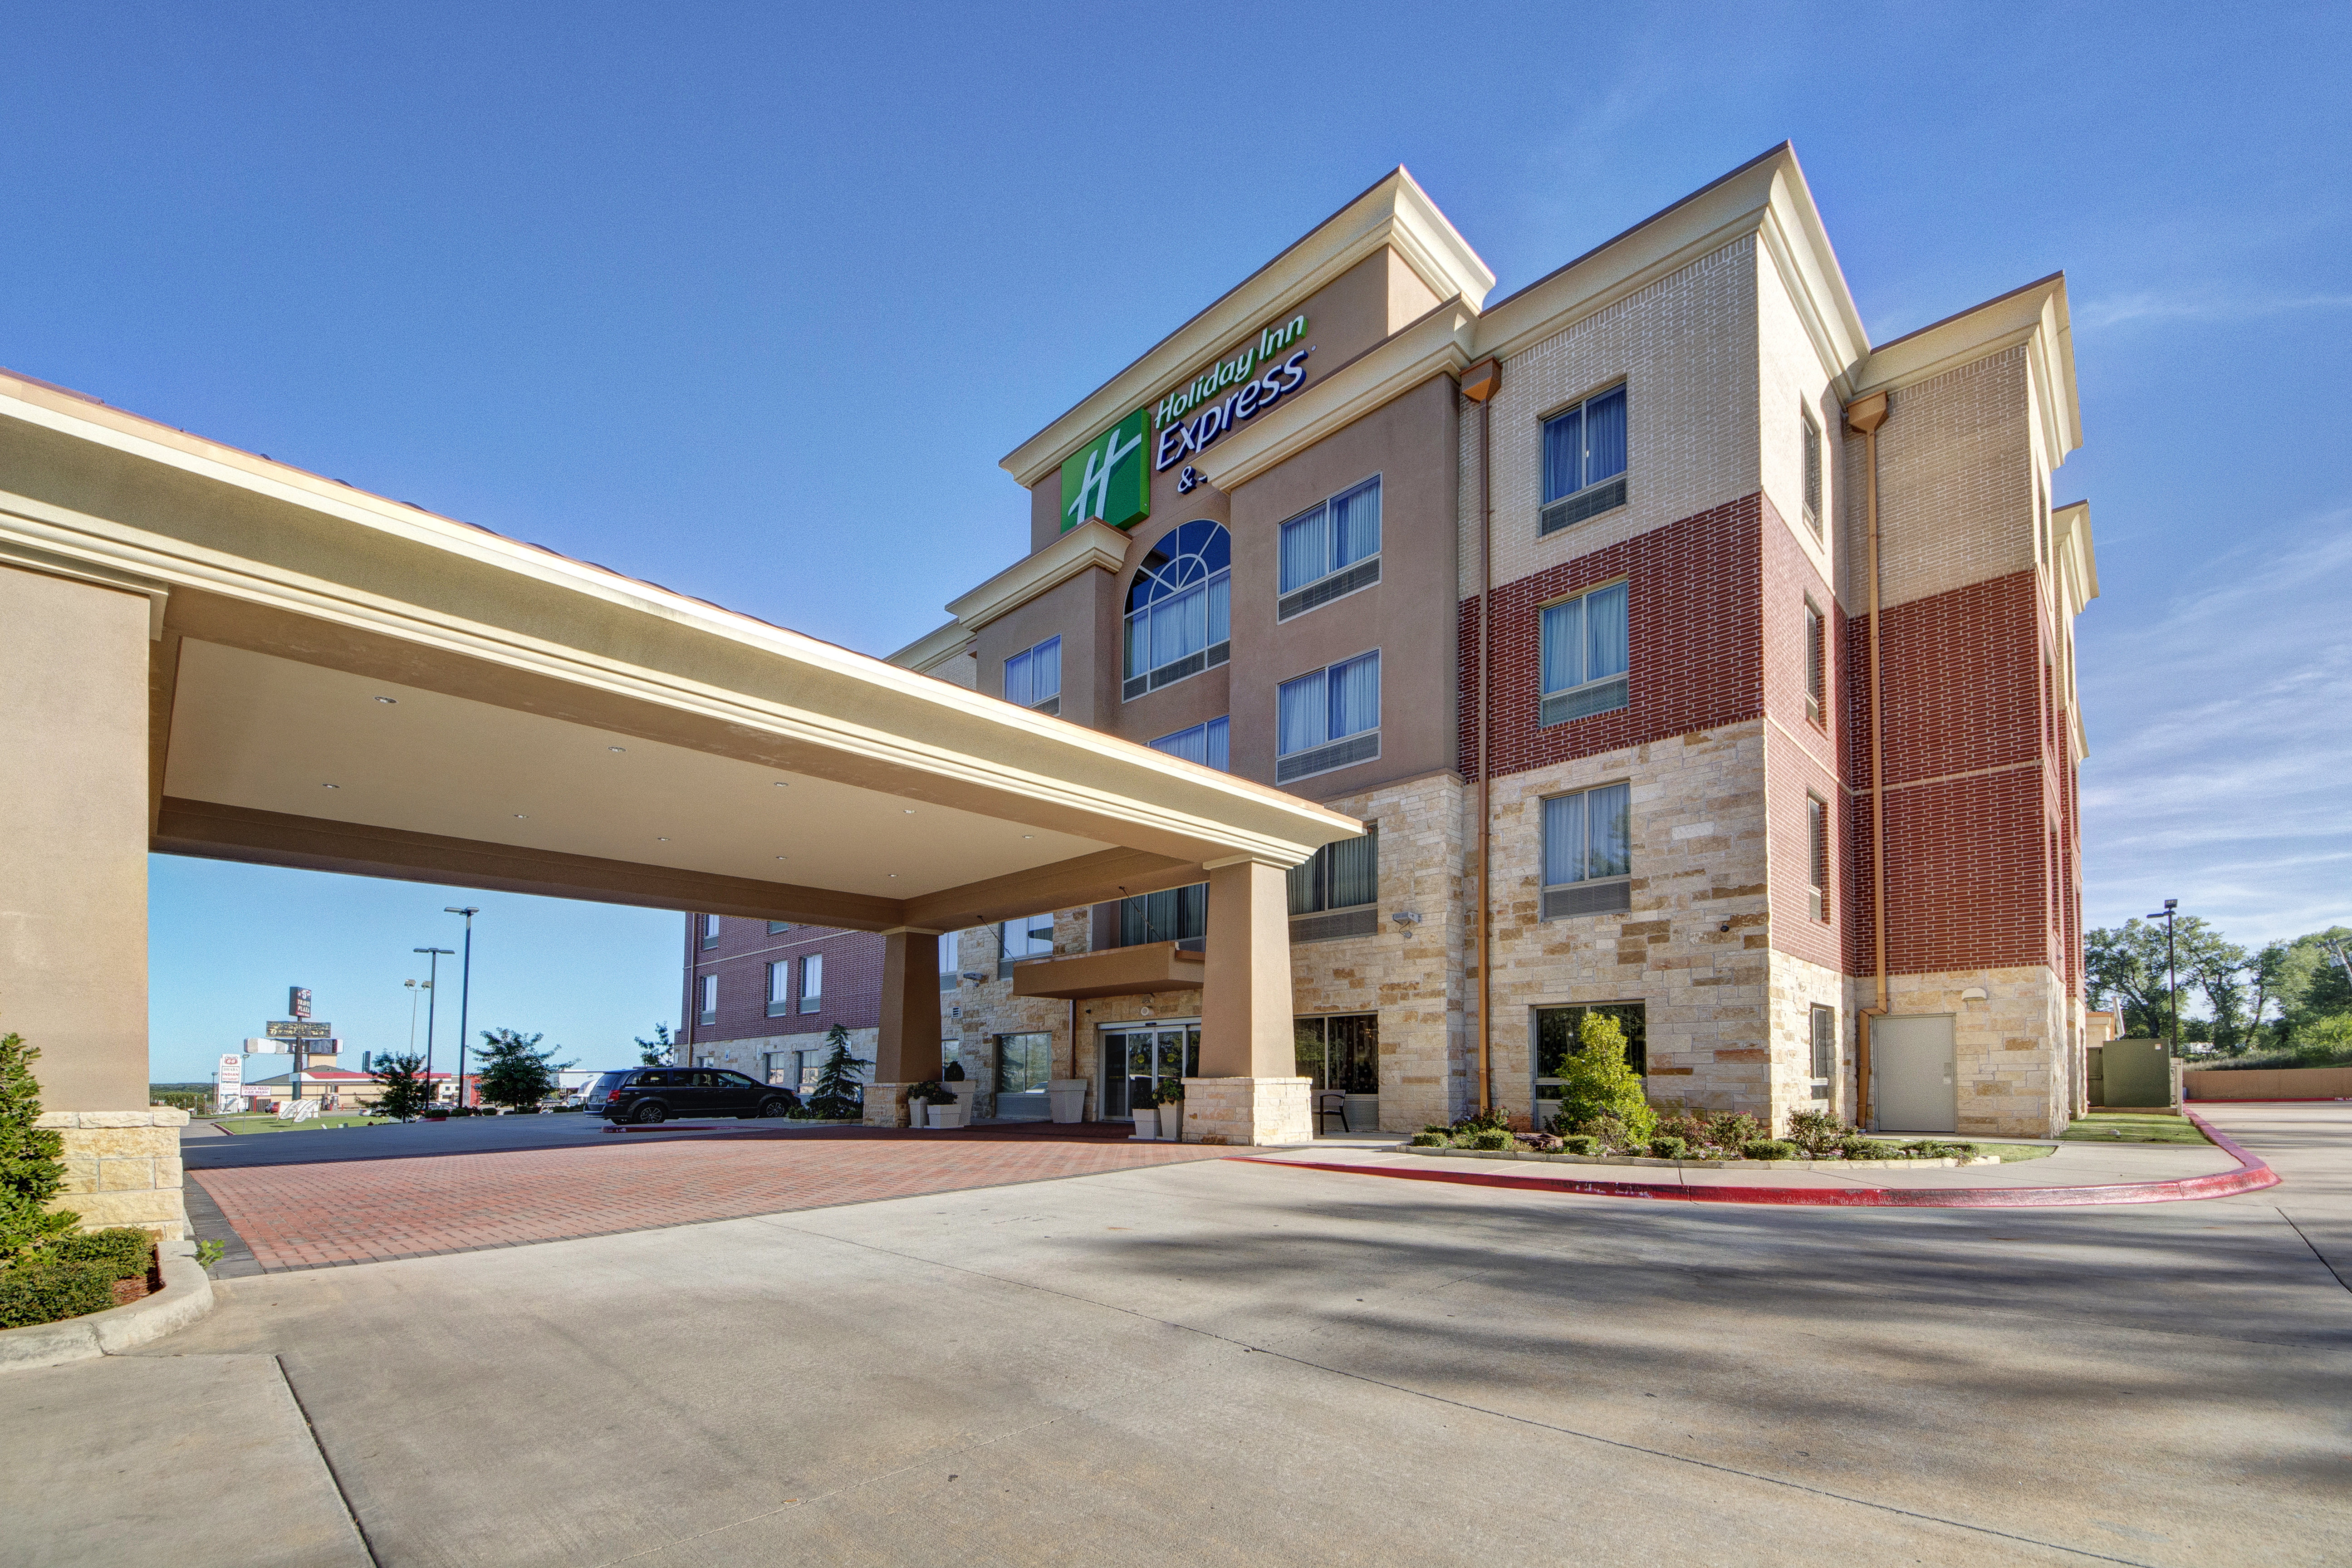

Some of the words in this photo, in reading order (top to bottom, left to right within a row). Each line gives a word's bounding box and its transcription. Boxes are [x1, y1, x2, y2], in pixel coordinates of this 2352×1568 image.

[1155, 348, 1258, 430] Holiday
[1259, 315, 1307, 363] Inn
[1156, 350, 1308, 472] Express
[1177, 465, 1197, 494] &
